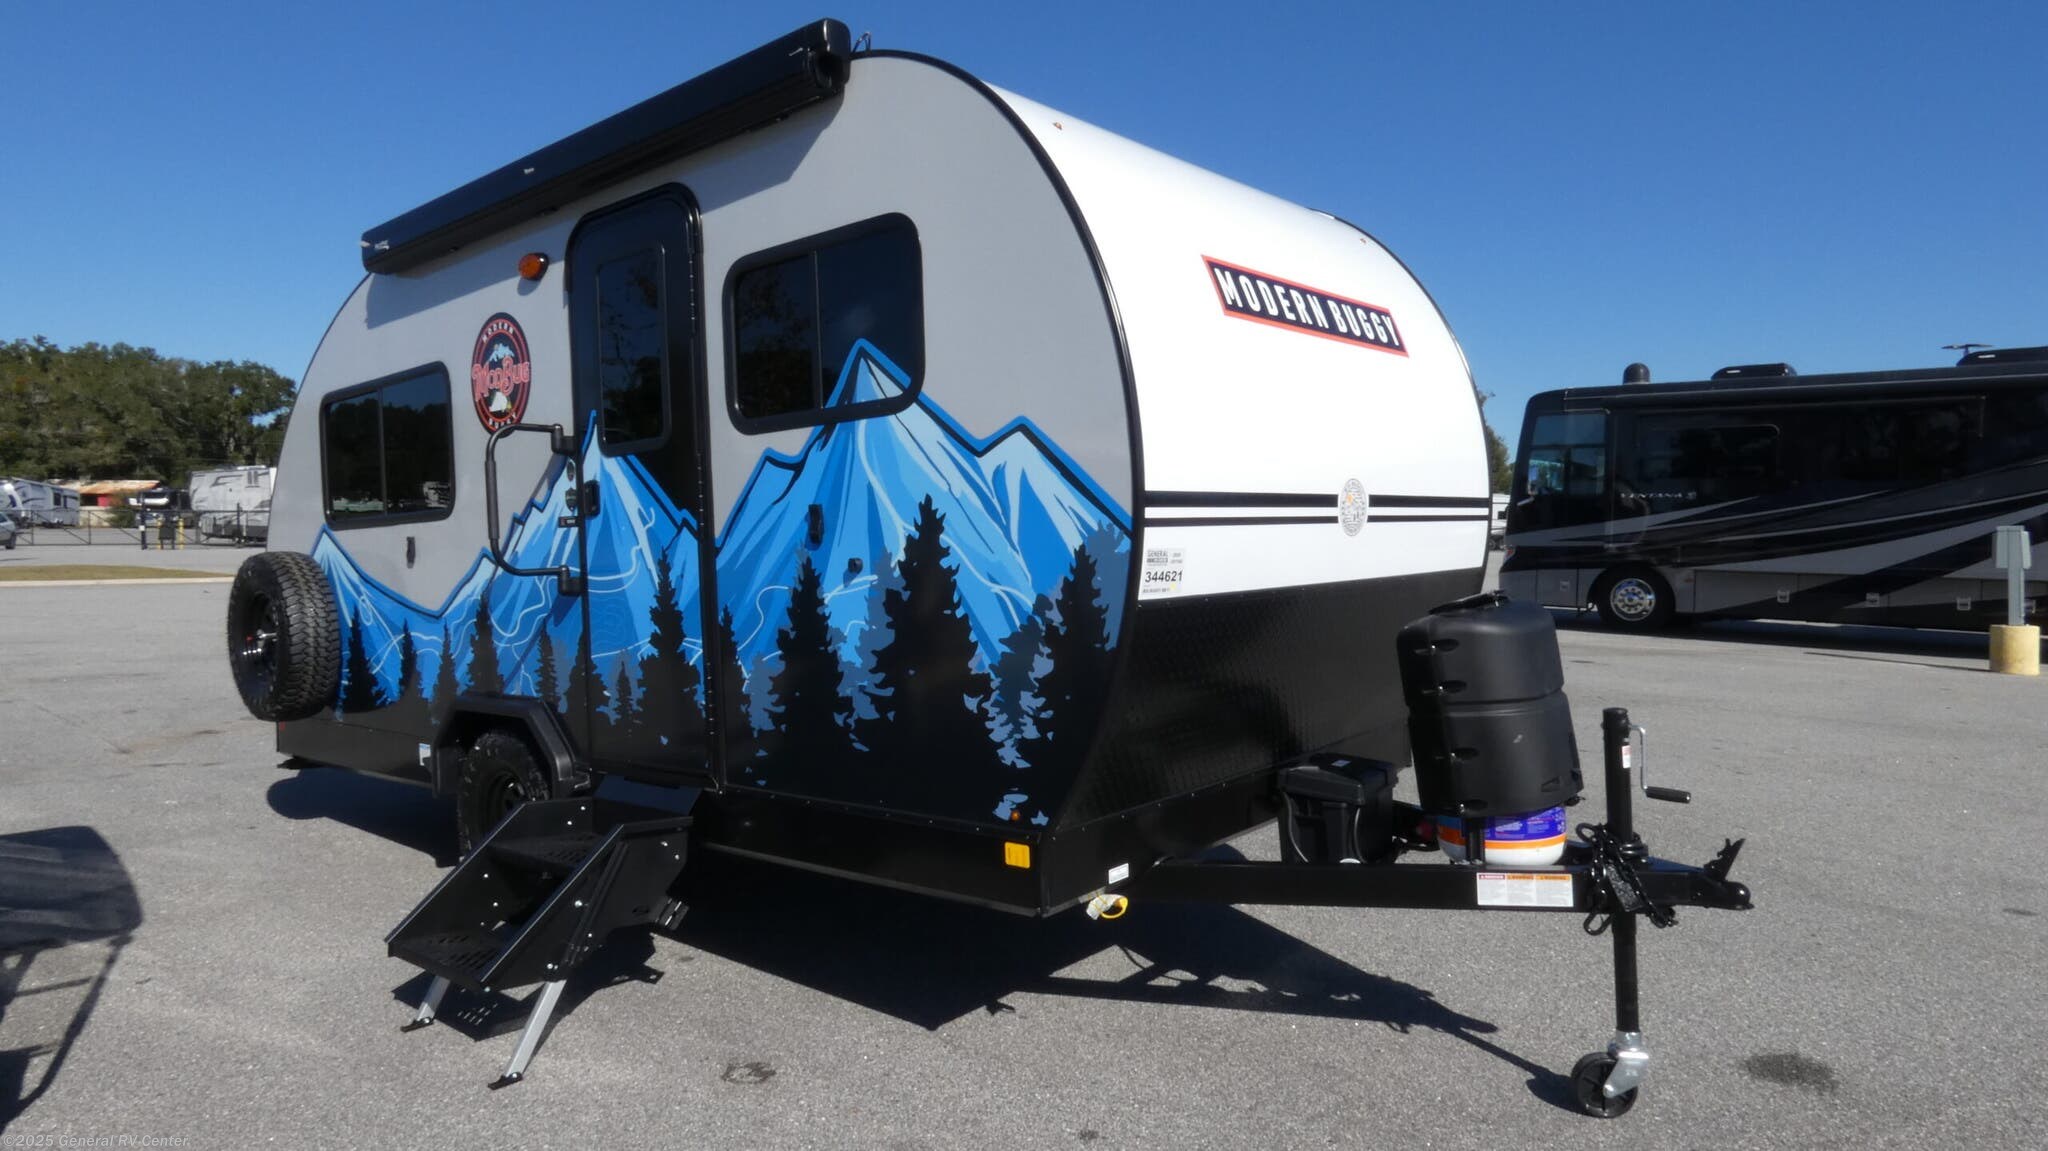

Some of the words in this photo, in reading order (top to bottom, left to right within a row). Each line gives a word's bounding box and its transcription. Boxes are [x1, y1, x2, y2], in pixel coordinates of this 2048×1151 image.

[1213, 267, 1329, 330] MODERN
[1326, 299, 1400, 346] BUGGY
[481, 322, 514, 343] MODERN
[1145, 570, 1183, 583] 344621
